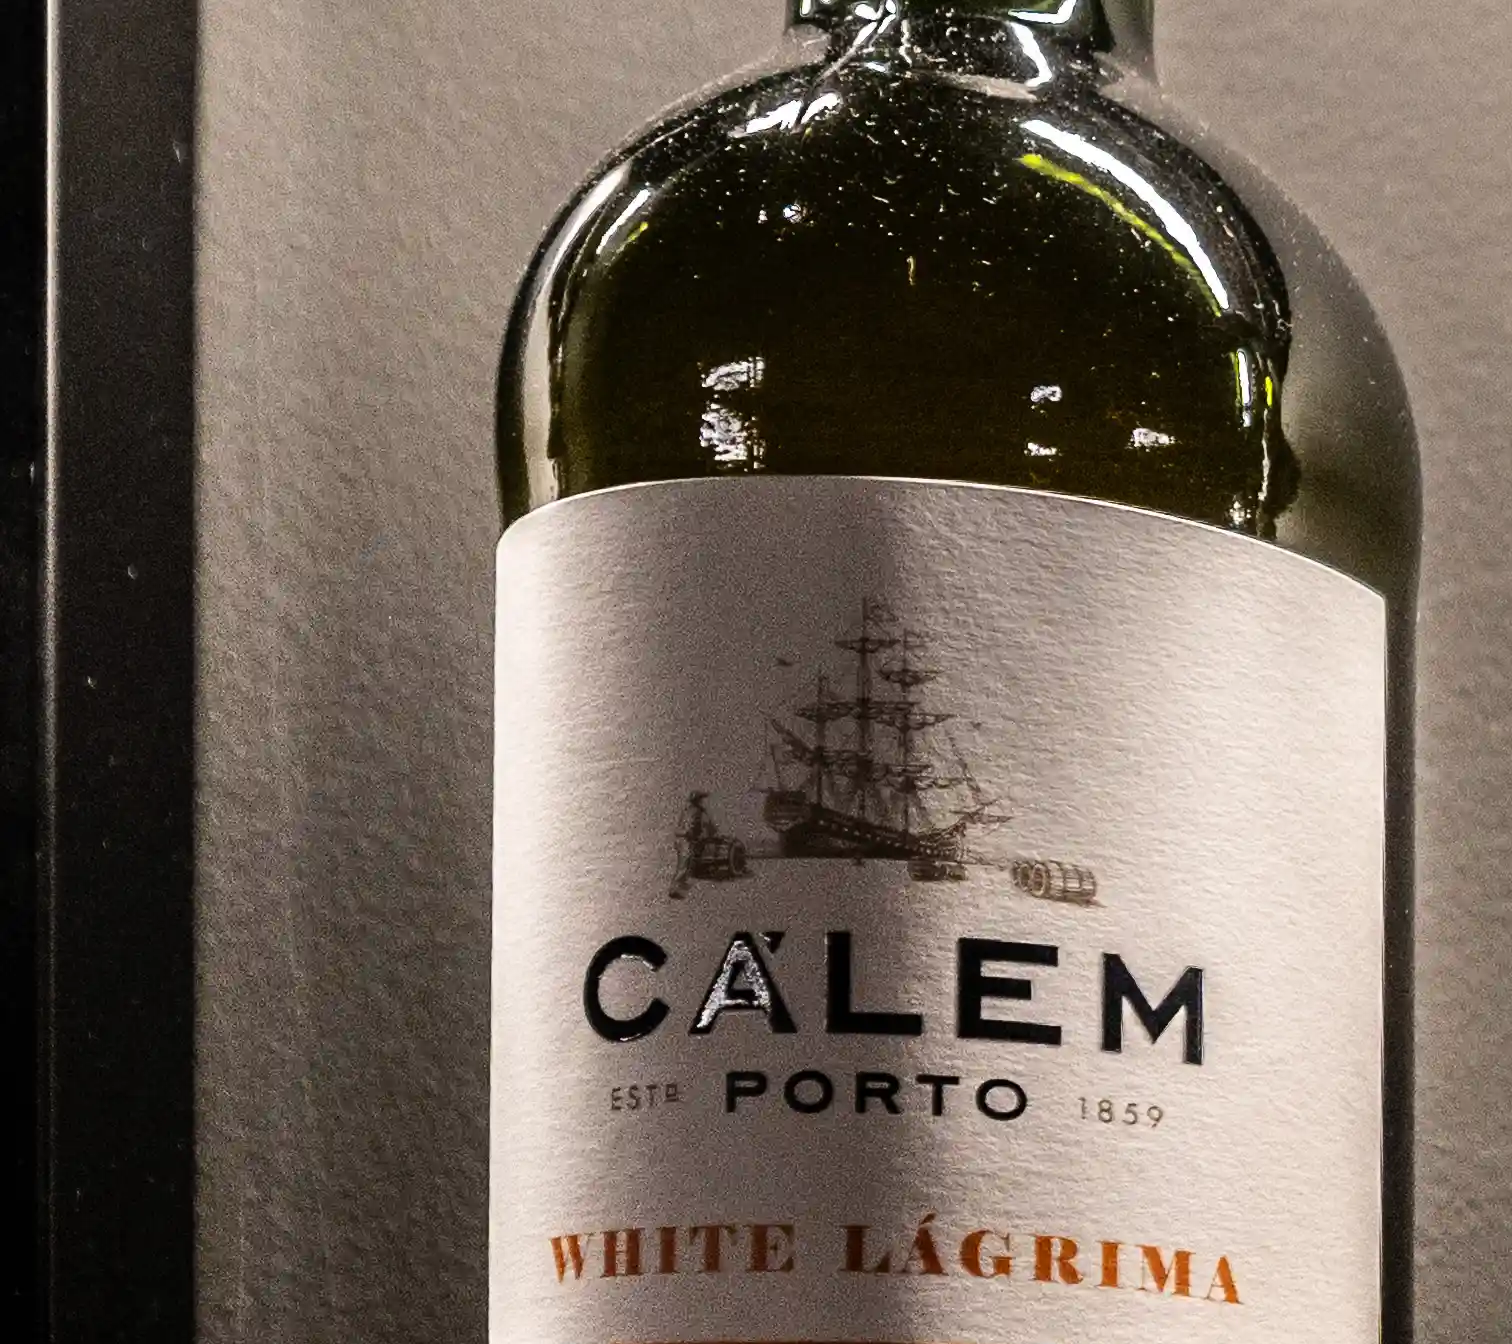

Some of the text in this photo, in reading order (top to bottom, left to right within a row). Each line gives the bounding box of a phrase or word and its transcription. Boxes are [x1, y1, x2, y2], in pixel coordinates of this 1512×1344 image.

[724, 1069, 1030, 1123] PORTO
[1078, 1096, 1166, 1130] 1859
[547, 1213, 1244, 1307] WHITE LÁGRIMA
